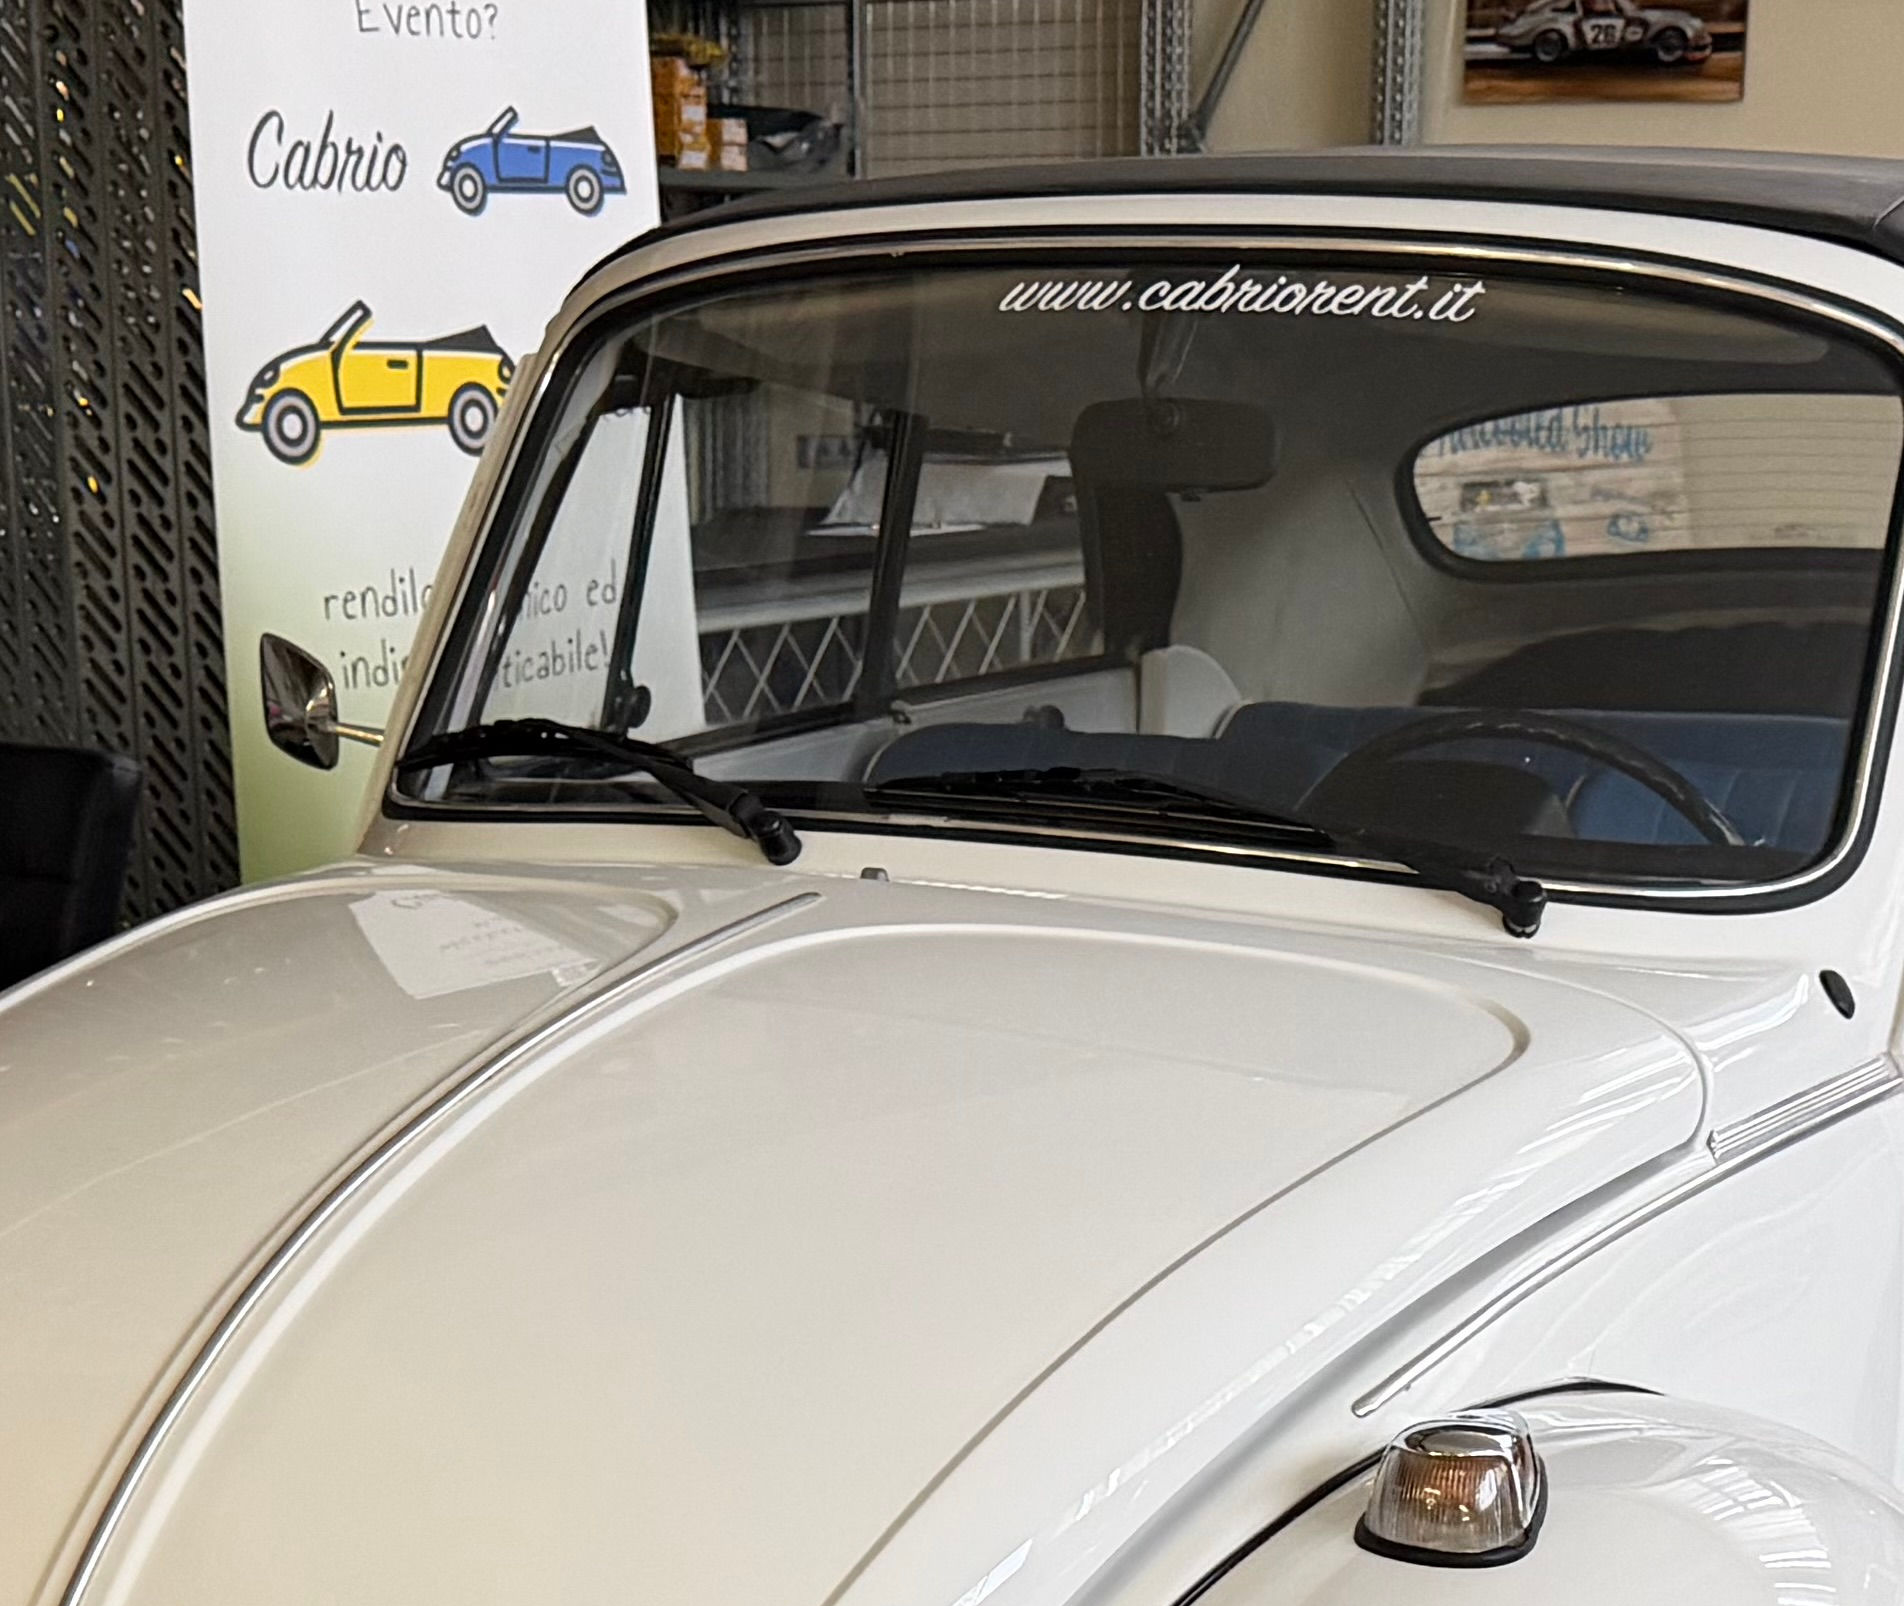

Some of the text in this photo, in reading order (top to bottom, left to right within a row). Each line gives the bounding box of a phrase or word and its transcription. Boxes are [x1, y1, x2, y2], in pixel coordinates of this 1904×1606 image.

[355, 0, 498, 40] Evento?
[247, 108, 408, 194] Cabrio
[998, 263, 1487, 323] www.cabriorent.it
[585, 557, 617, 608] ed
